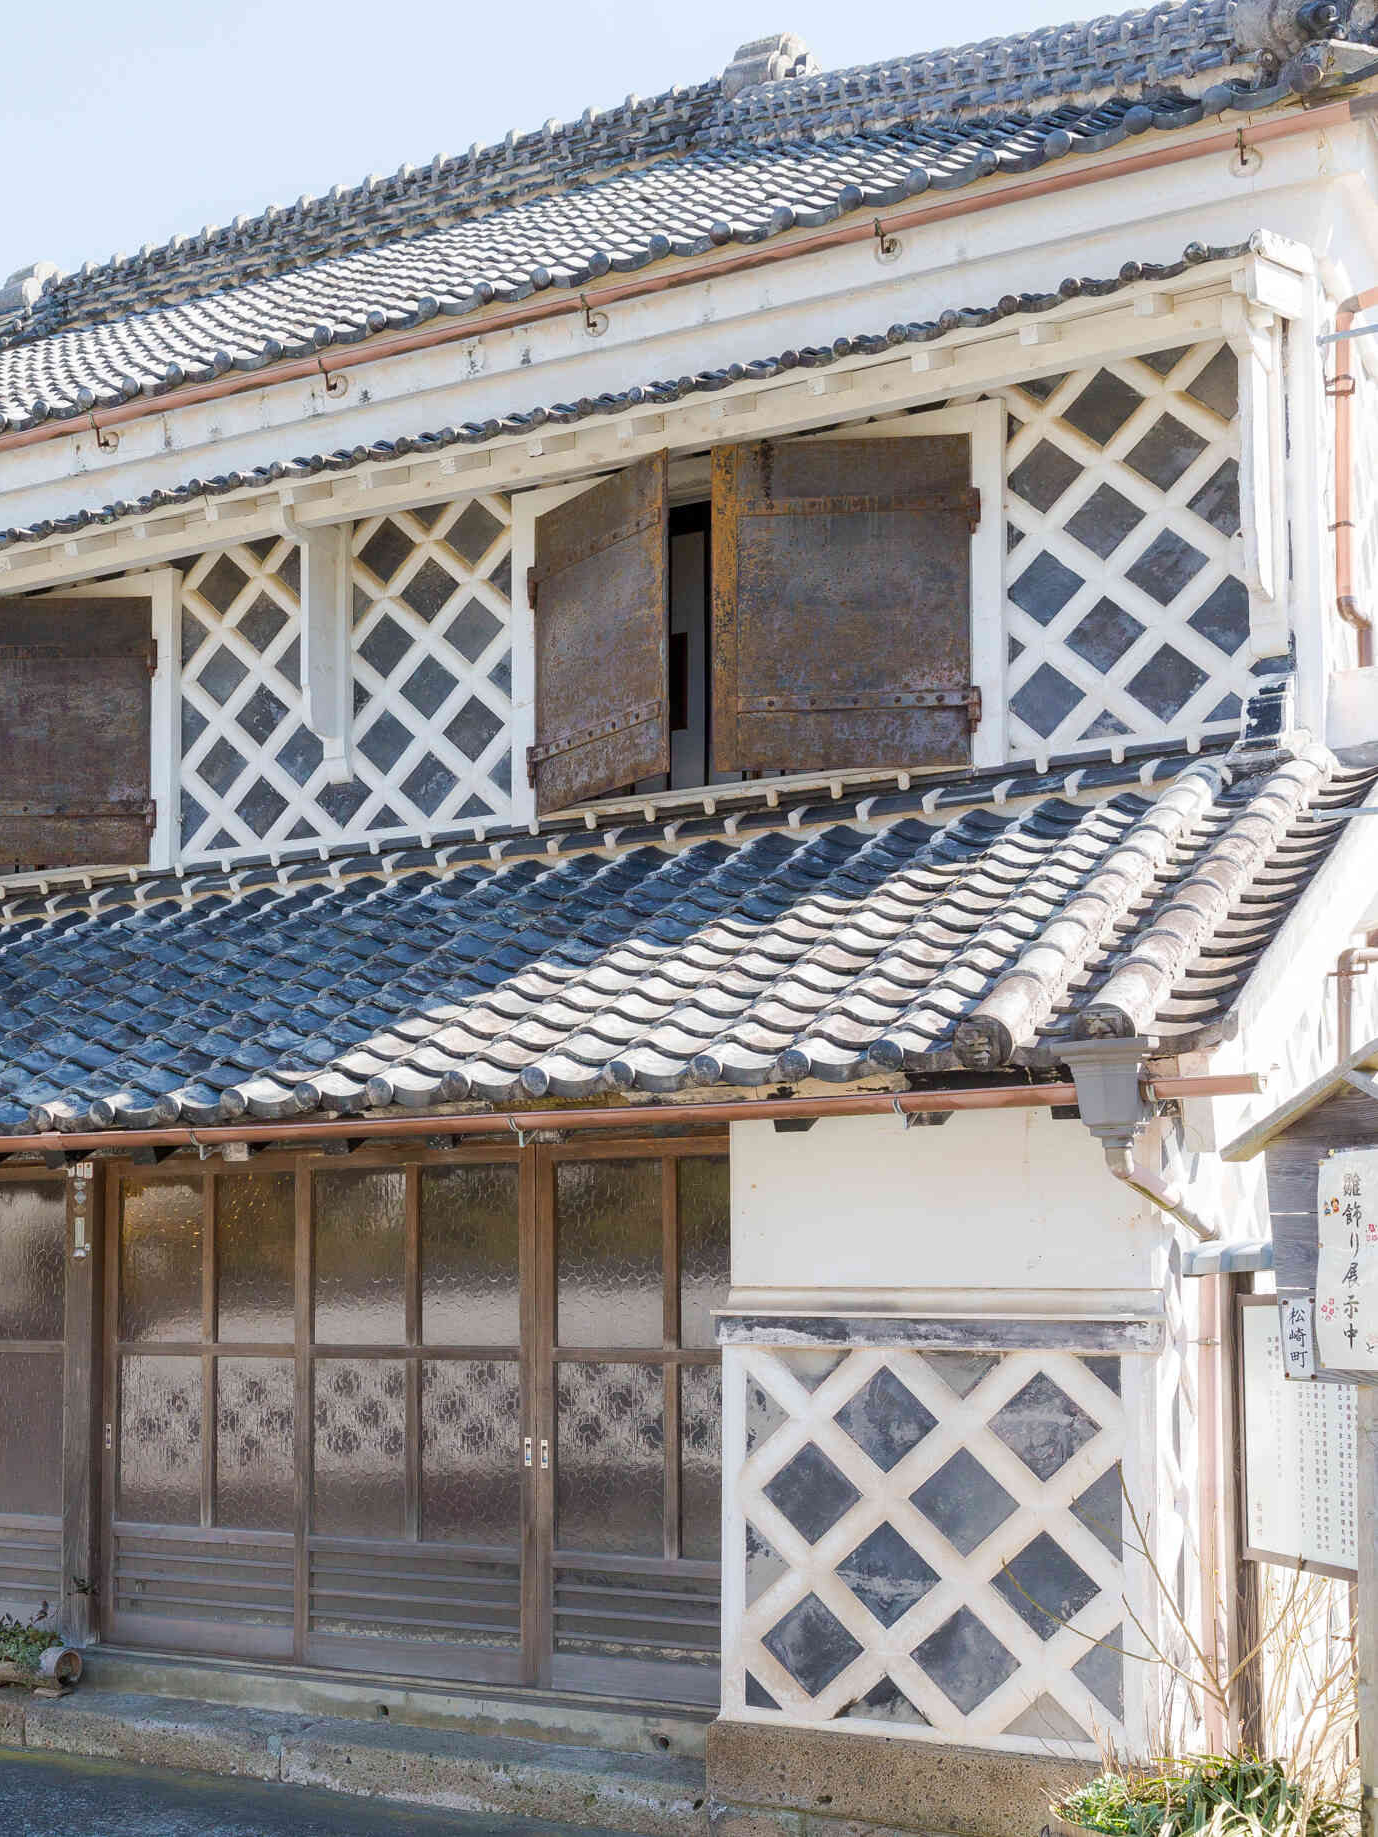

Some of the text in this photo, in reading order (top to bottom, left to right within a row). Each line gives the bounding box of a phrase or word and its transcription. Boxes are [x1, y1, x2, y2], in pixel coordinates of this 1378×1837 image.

[1342, 1172, 1362, 1350] 雛飾り展示中
[1289, 1307, 1308, 1368] 松崎町
